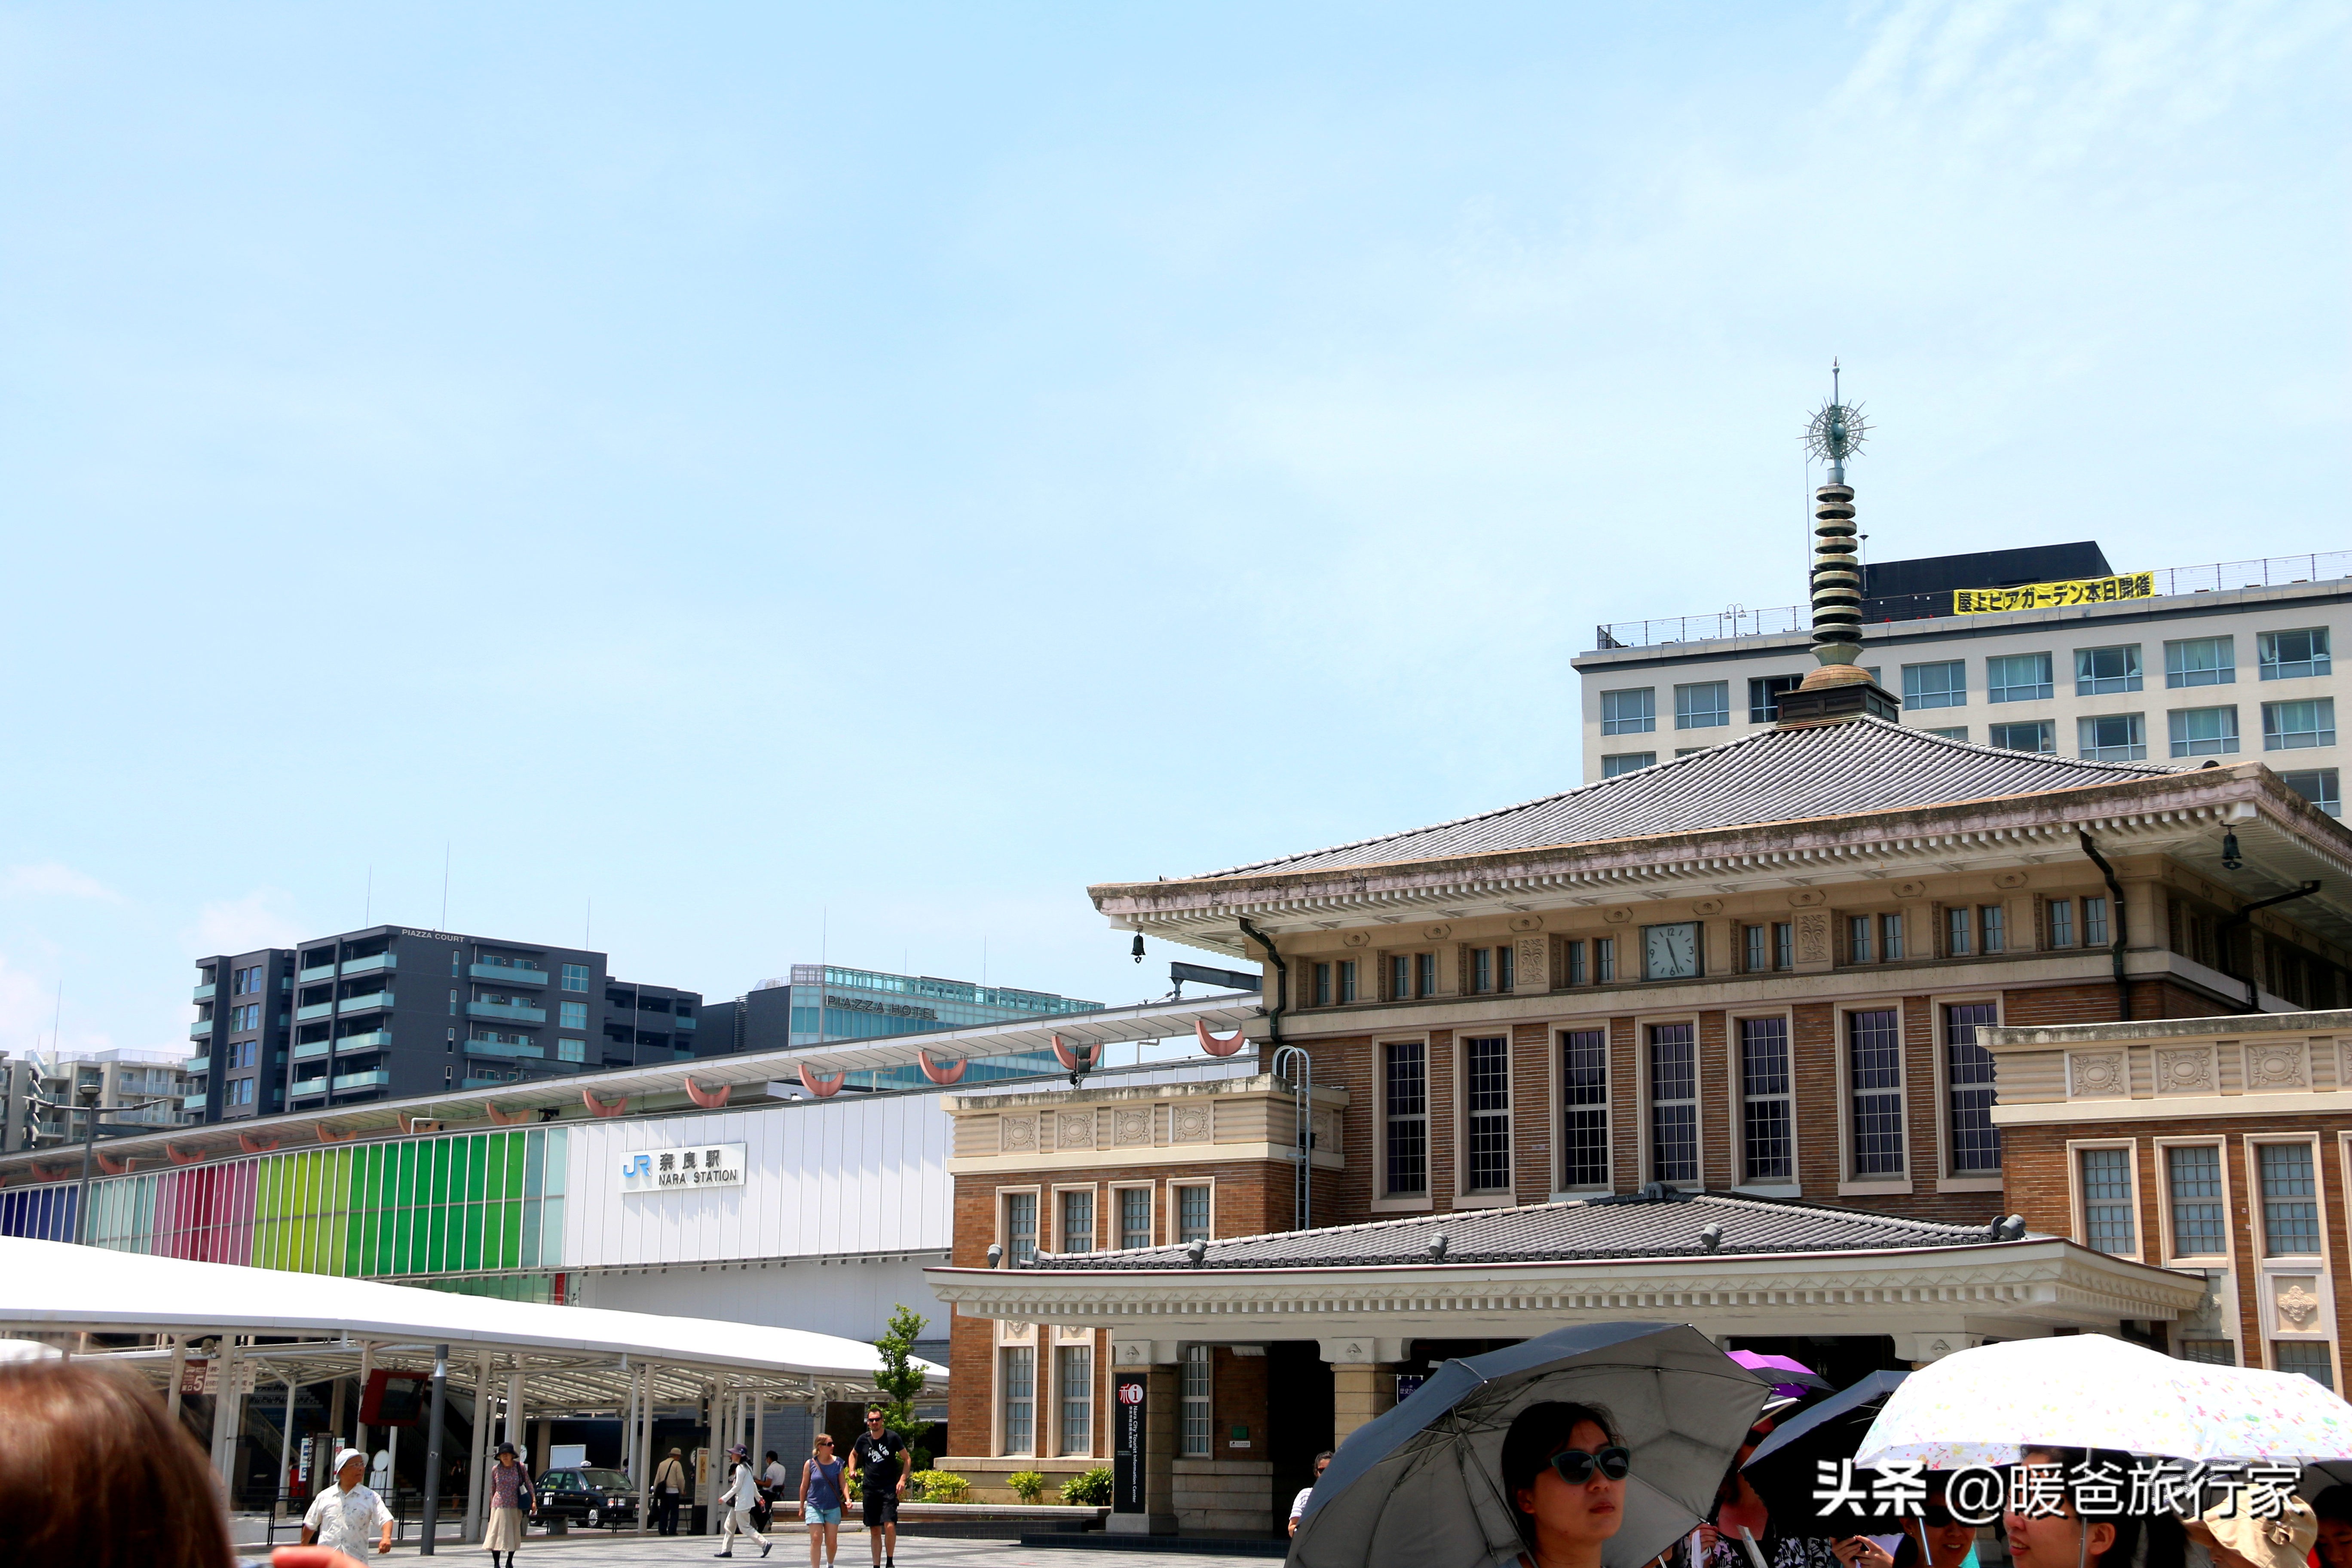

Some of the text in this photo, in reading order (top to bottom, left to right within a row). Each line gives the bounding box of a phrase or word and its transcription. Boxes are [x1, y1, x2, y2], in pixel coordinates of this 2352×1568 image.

[1957, 575, 2150, 612] 屋上ビアガーデン本日開催
[402, 929, 465, 942] PIAZZA COURT
[1668, 928, 1675, 936] 12
[1649, 949, 1655, 958] 9
[1689, 946, 1694, 954] 3
[1669, 966, 1675, 976] 6
[827, 995, 938, 1020] PIAZZA HOTEL
[623, 1155, 651, 1178] JR
[659, 1149, 721, 1171] 奈良駅
[659, 1169, 737, 1186] NARA STATION
[193, 1375, 204, 1391] 5
